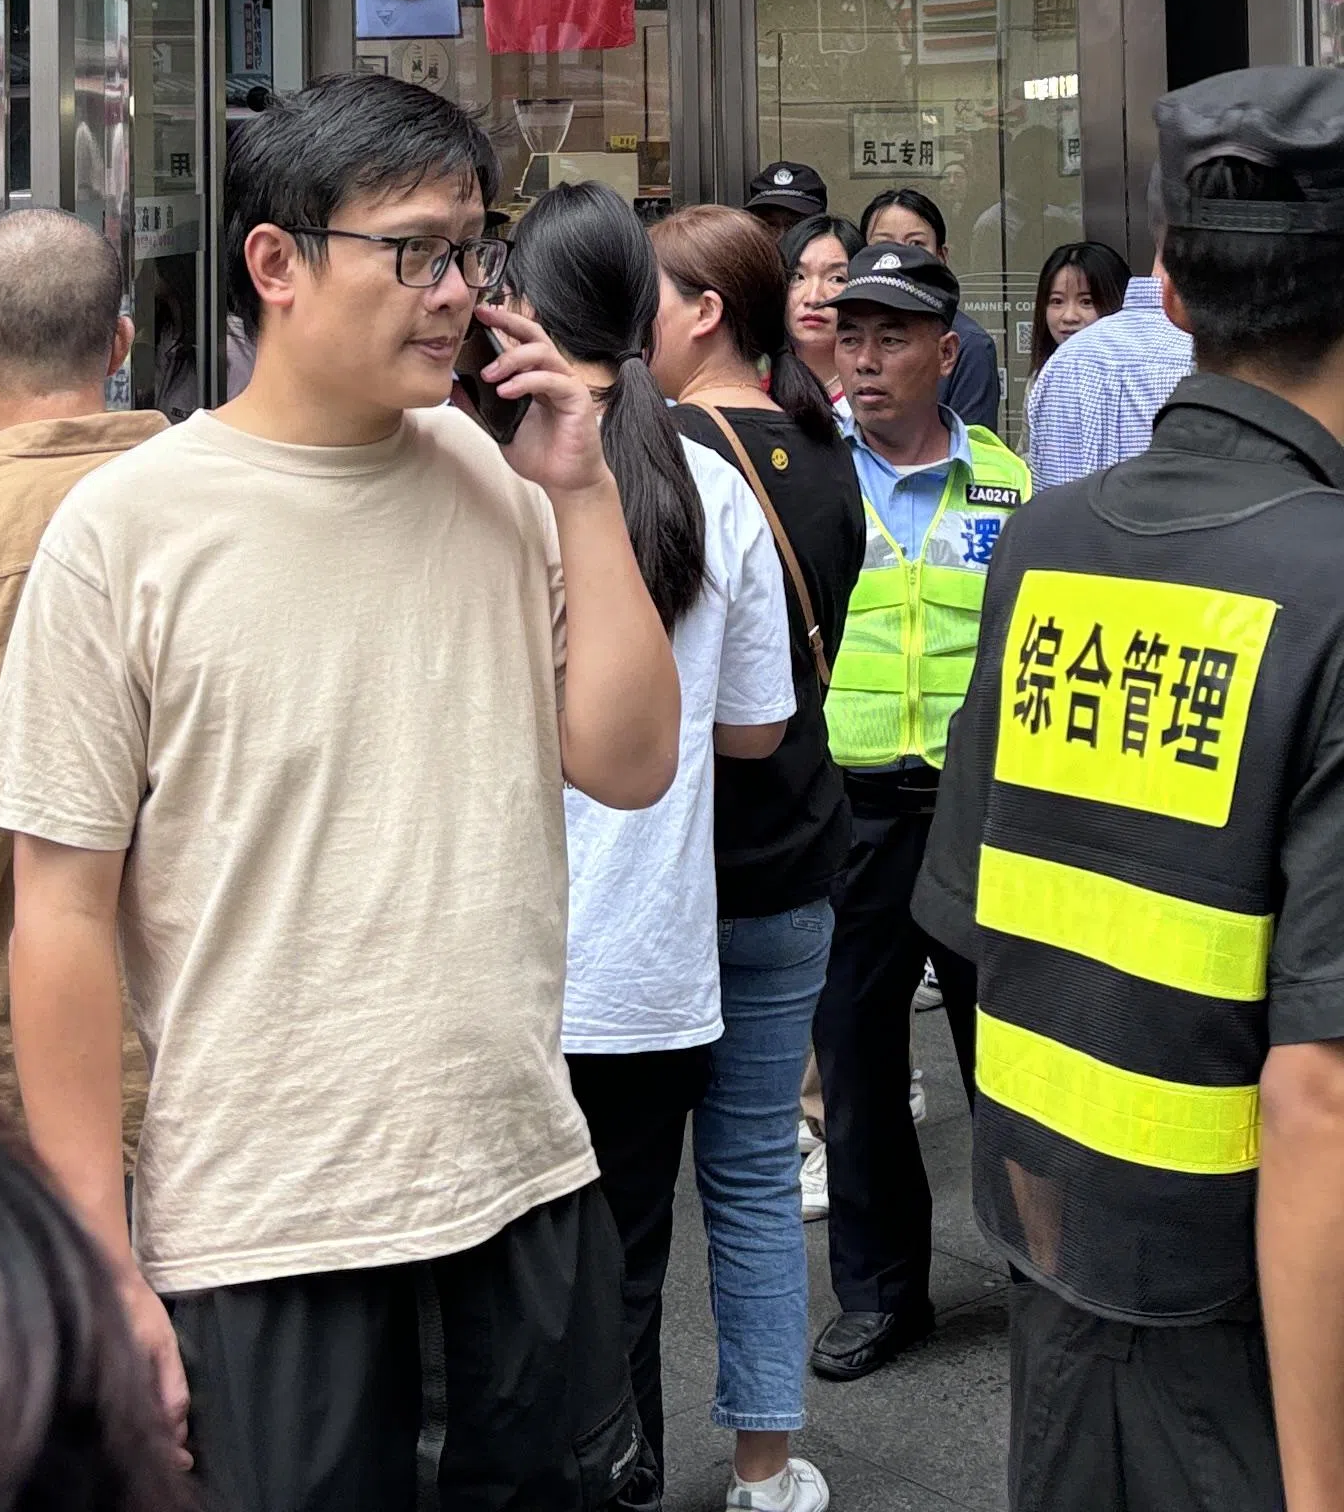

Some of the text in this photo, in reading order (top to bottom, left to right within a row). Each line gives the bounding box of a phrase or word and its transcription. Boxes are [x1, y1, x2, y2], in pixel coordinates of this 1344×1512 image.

[861, 139, 934, 167] 员工专用
[964, 301, 1012, 312] MANNER
[968, 488, 1018, 505] ZA0247
[960, 518, 1002, 564] 逻
[1012, 613, 1238, 772] 综合管理
